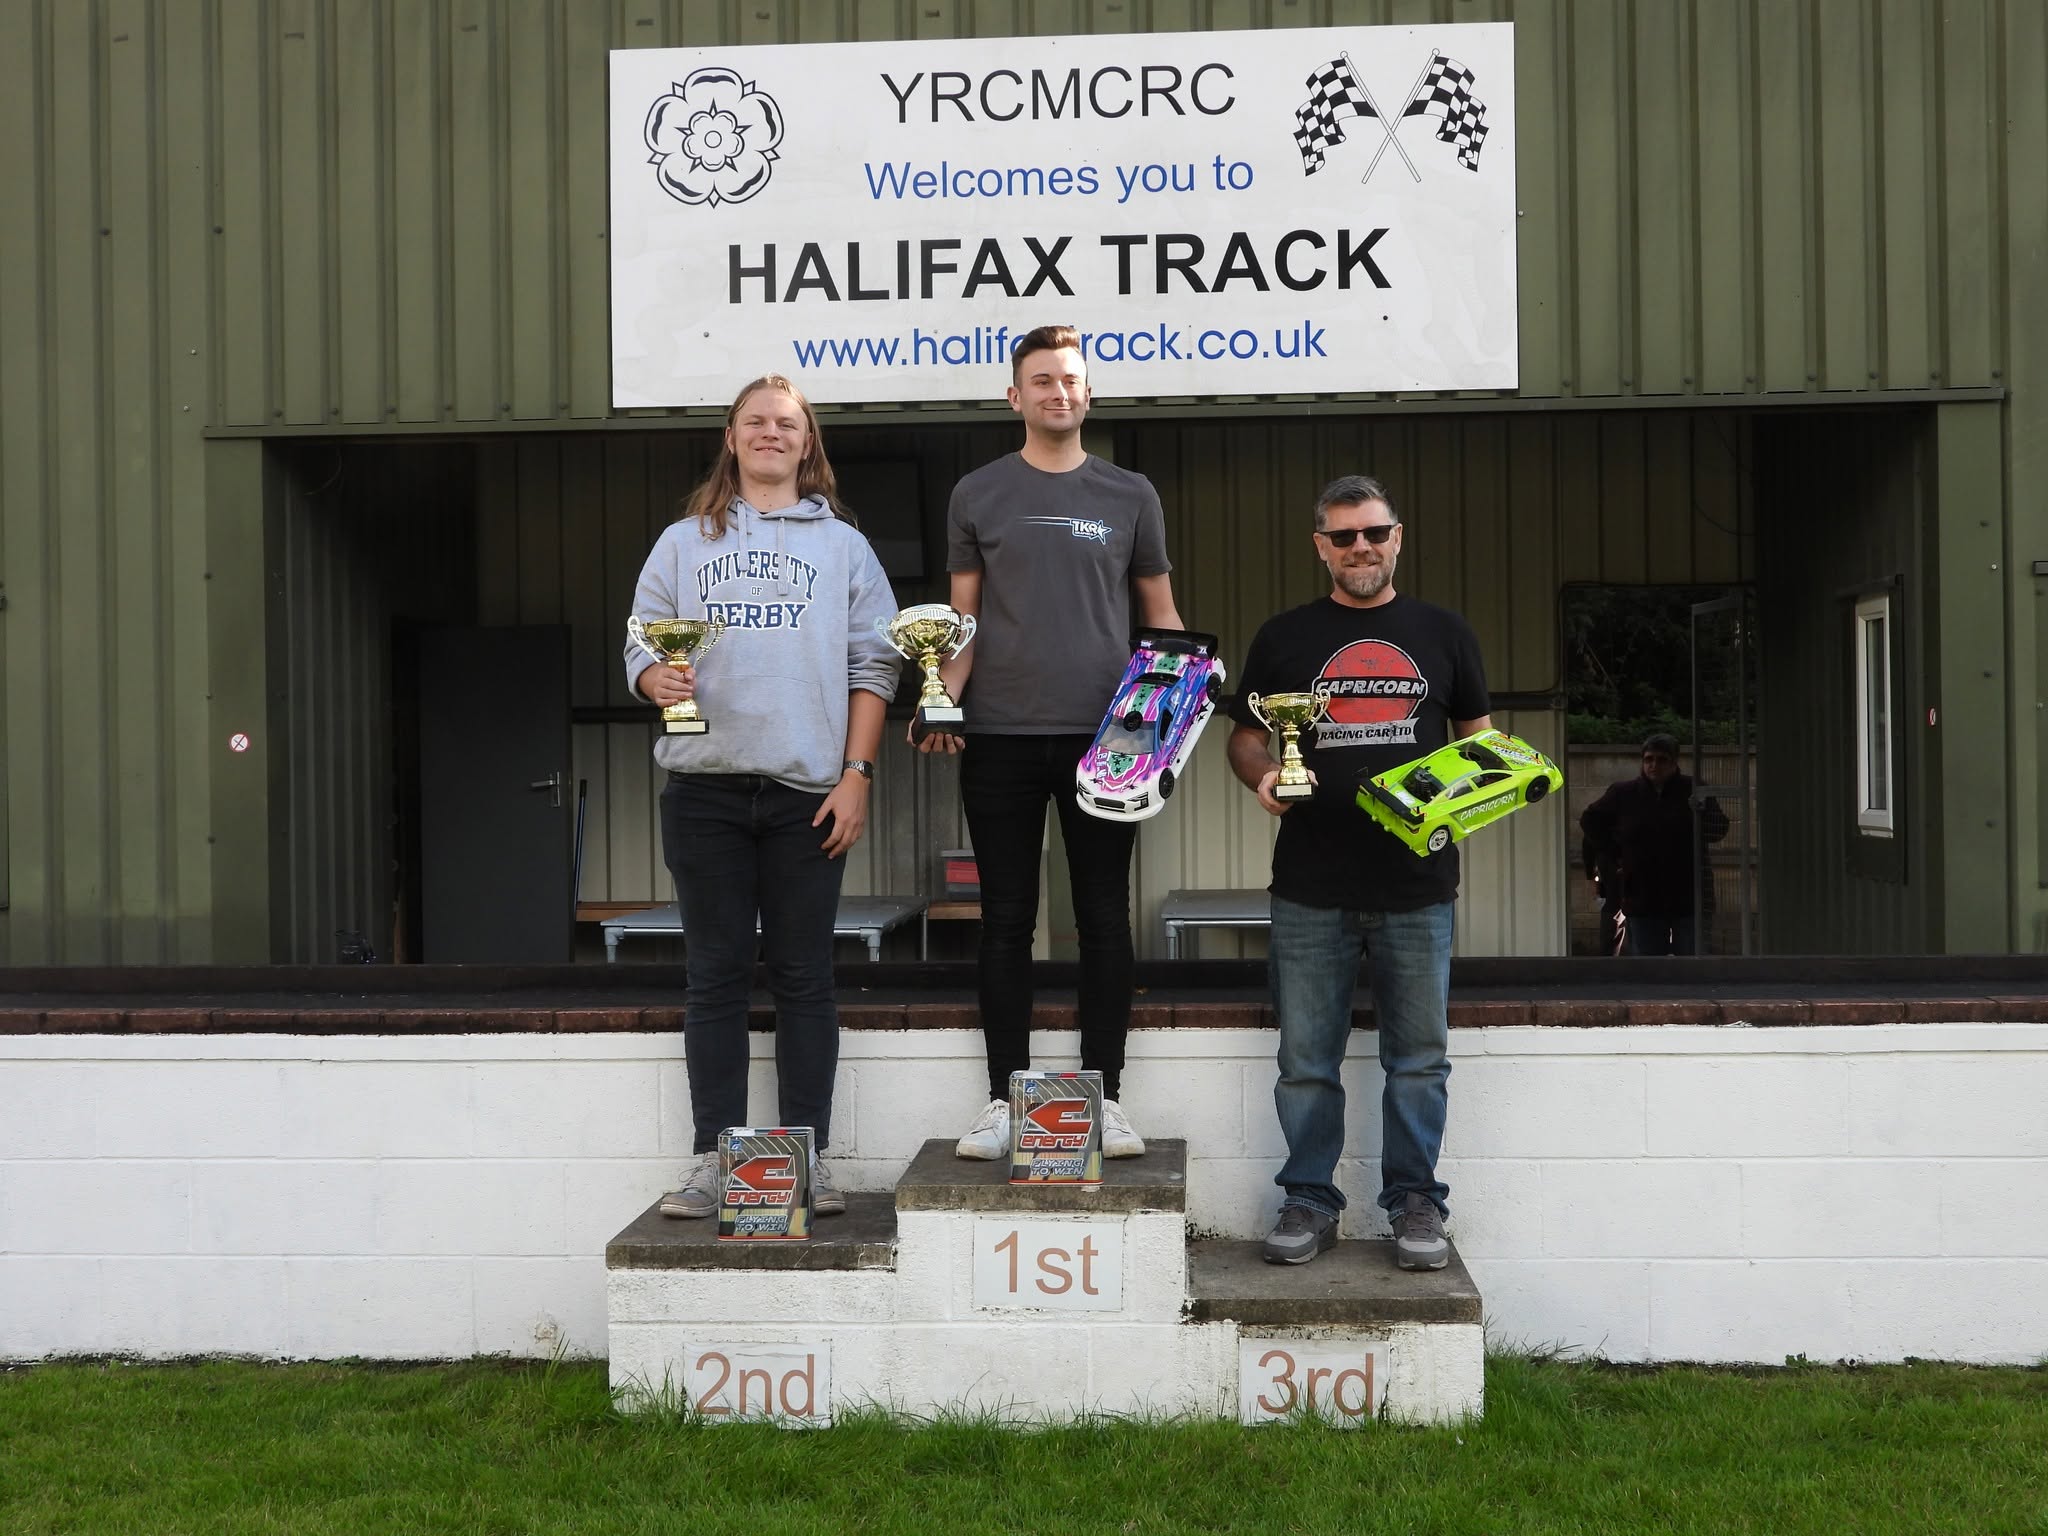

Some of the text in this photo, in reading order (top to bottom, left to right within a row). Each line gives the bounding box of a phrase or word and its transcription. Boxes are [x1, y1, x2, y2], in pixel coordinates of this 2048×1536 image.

[881, 63, 1235, 123] YRCMCRC
[865, 156, 1254, 204] Welcomes you to
[729, 228, 1392, 304] HALIFAX TRACK
[793, 320, 1327, 368] www.halifrack.co.uk
[751, 586, 763, 596] OF
[705, 602, 808, 630] DERBY
[1315, 680, 1426, 695] CAPRICORN
[1320, 724, 1412, 741] RACING CAR LTD
[1031, 1159, 1084, 1168] FLYING
[1031, 1167, 1084, 1176] TO WIN
[736, 1215, 787, 1224] FLYING
[736, 1223, 788, 1232] TO WIN
[994, 1230, 1099, 1295] 1st
[696, 1351, 815, 1416] 2nd
[1257, 1350, 1374, 1417] 3rd
